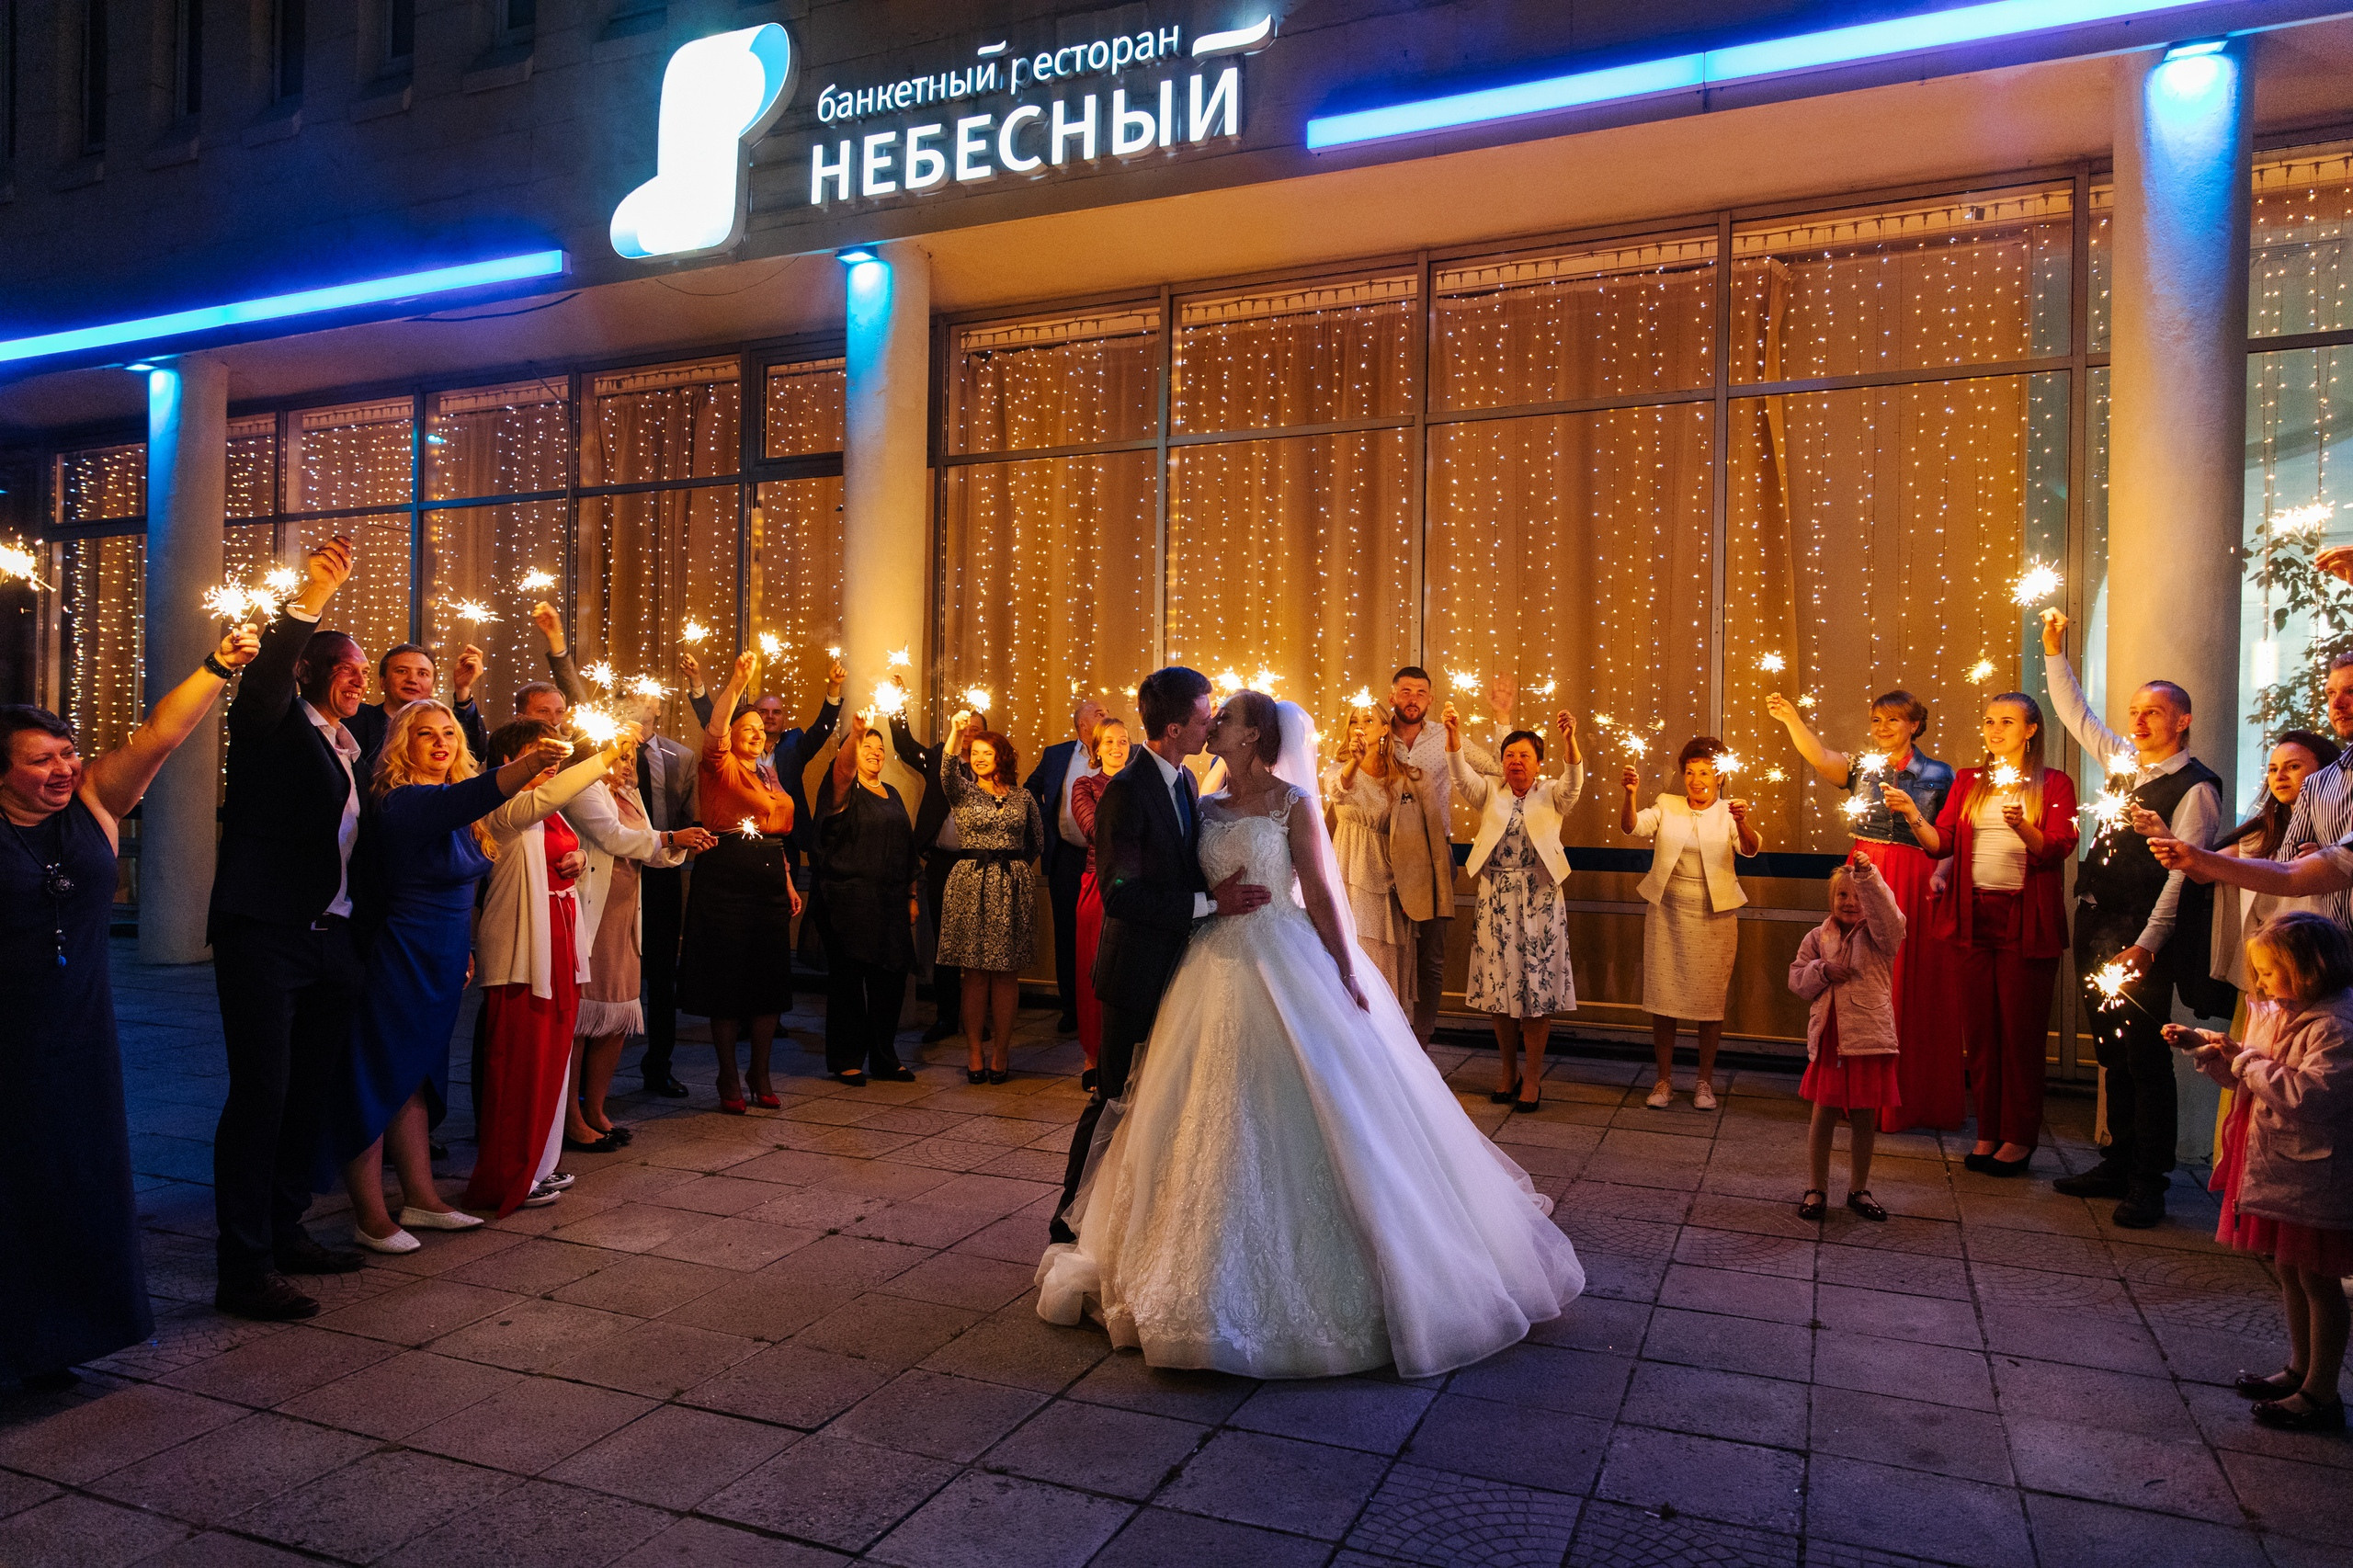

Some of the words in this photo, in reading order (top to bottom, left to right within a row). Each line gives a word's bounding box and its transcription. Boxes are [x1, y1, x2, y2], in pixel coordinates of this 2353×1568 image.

[811, 14, 1272, 205] НЕБЕСНЫЙ
[817, 40, 1006, 122] банкетный
[1010, 25, 1179, 95] ресторан
